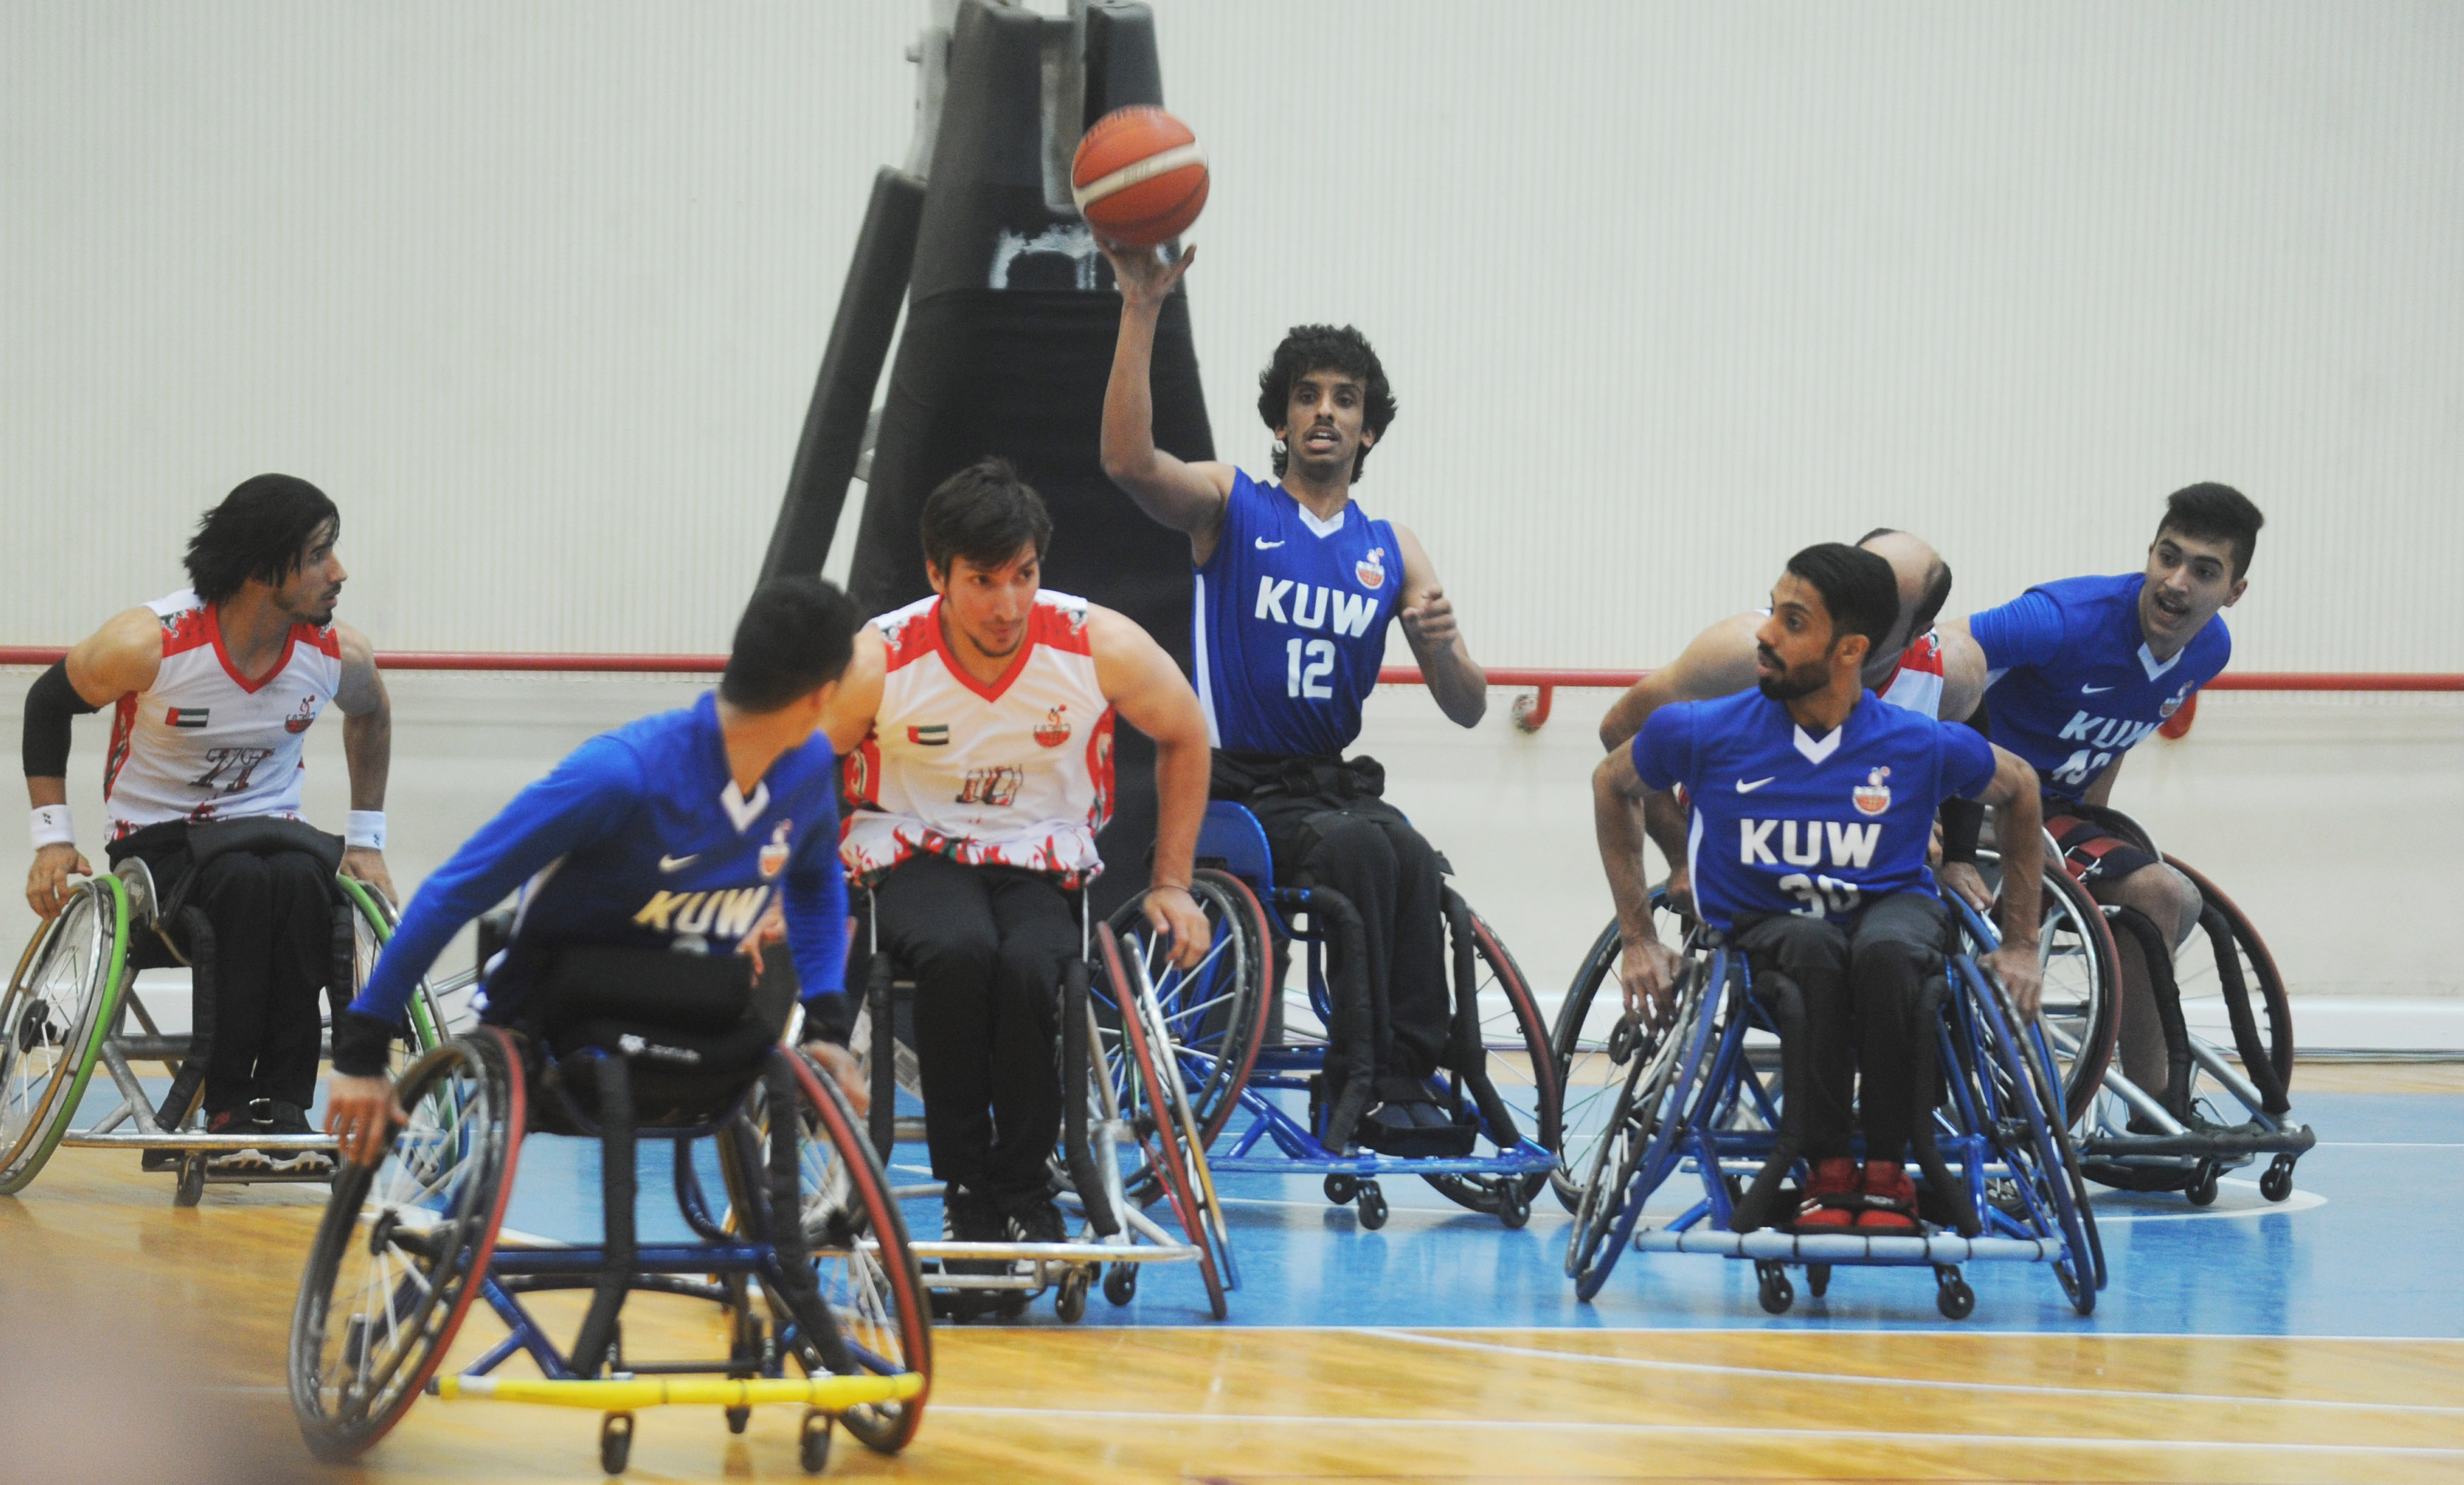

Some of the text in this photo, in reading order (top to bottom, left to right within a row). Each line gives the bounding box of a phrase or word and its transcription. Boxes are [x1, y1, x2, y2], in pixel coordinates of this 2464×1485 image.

[1255, 576, 1378, 638] KUW
[1286, 638, 1335, 699] 12
[1740, 818, 1882, 868] KUW
[632, 885, 770, 939] KUW
[1779, 873, 1861, 918] 30
